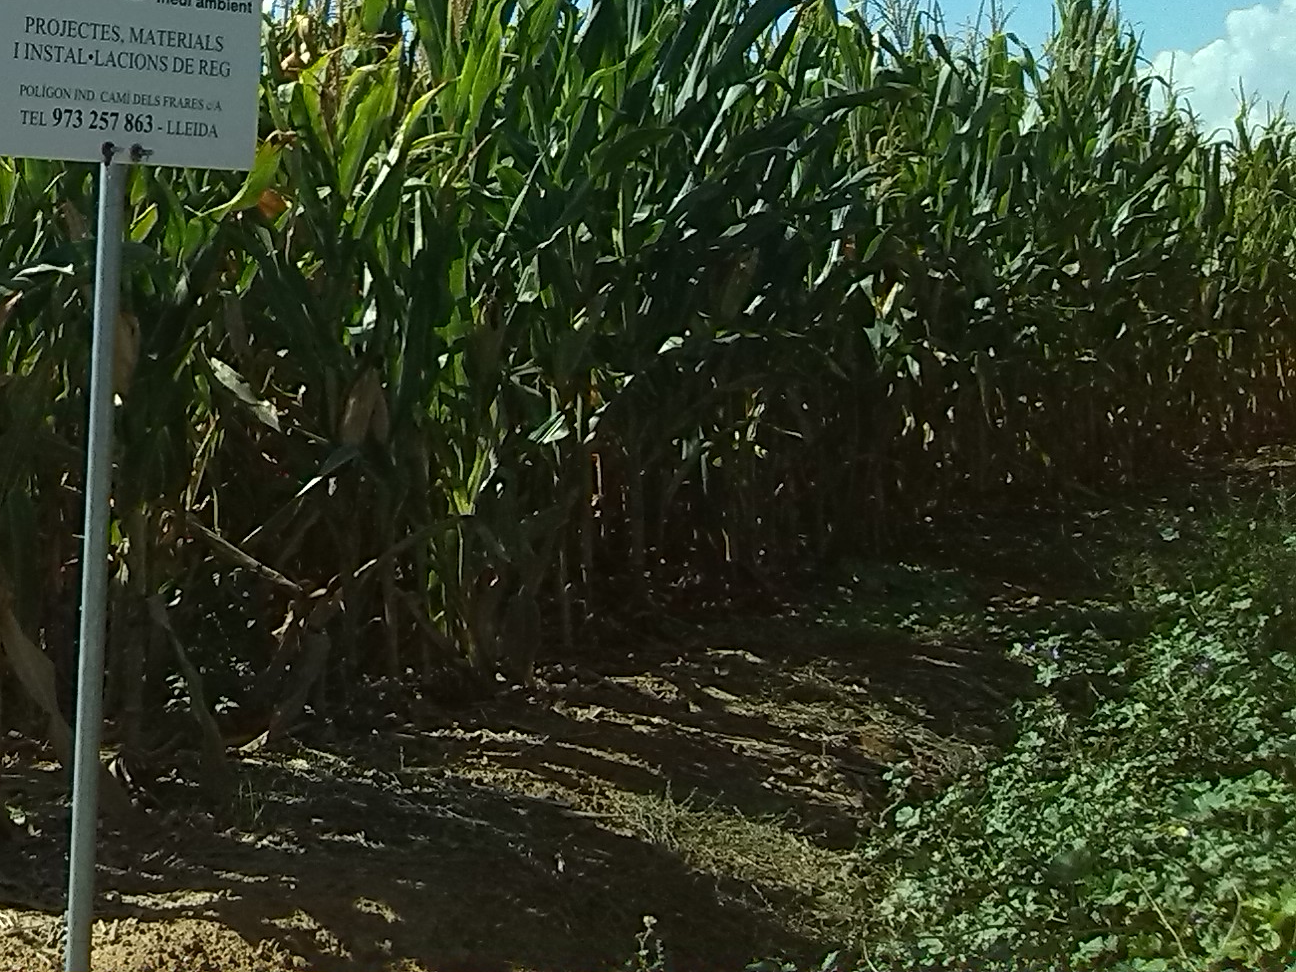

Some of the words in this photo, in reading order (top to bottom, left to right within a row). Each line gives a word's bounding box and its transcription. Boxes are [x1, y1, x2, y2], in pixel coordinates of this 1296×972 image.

[24, 16, 125, 44] PROJECTES,
[129, 26, 224, 52] MATERIALS
[13, 41, 20, 60] I
[172, 57, 194, 75] DE
[198, 59, 231, 78] REG
[132, 93, 161, 107] DELS
[163, 95, 205, 110] FRARES
[20, 109, 47, 127] TEL
[52, 107, 83, 129] 973
[88, 109, 119, 131] 257
[123, 113, 154, 133] 863
[166, 119, 219, 138] LLEIDA
